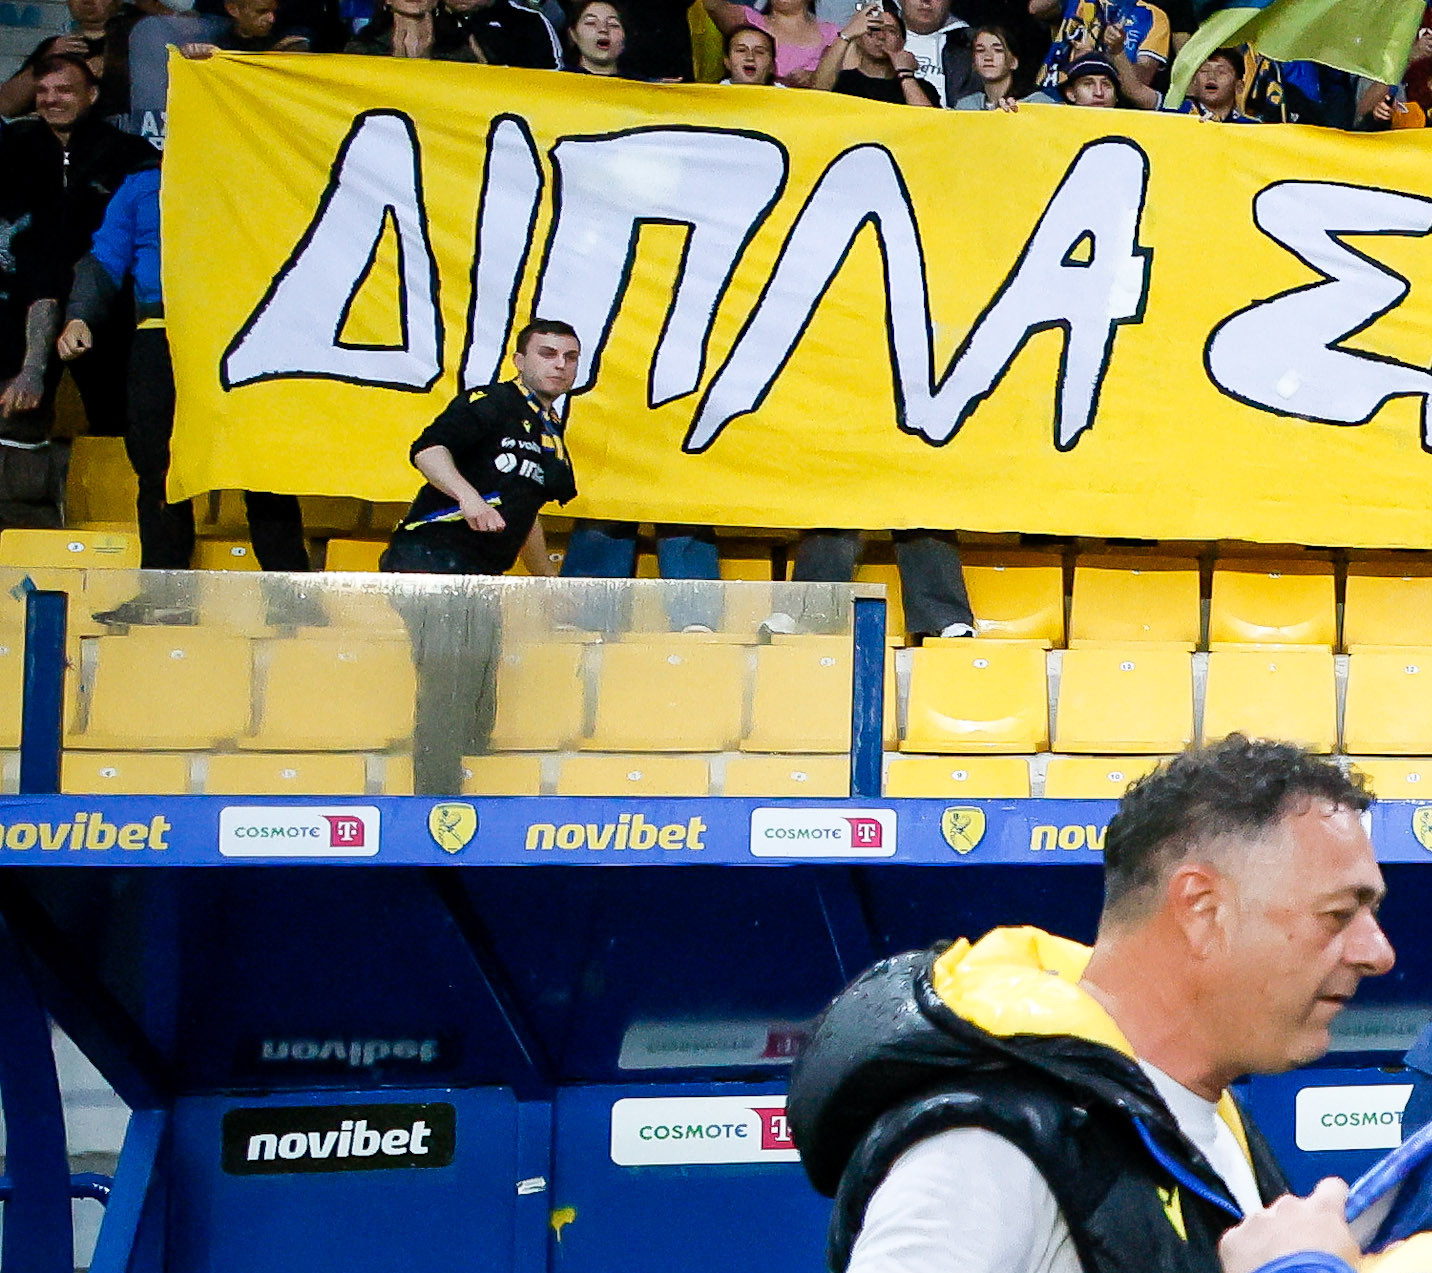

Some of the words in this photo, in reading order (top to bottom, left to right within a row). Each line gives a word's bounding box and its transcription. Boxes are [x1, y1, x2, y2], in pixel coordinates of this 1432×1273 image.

[220, 108, 1153, 455] ΔΙΠΛΑ
[233, 826, 321, 840] COSMOTE
[525, 812, 708, 851] novibet
[764, 826, 842, 840] COSMOTE
[1320, 1111, 1404, 1128] COSMOT
[247, 1119, 432, 1162] novibet
[638, 1122, 748, 1141] COSMOTE
